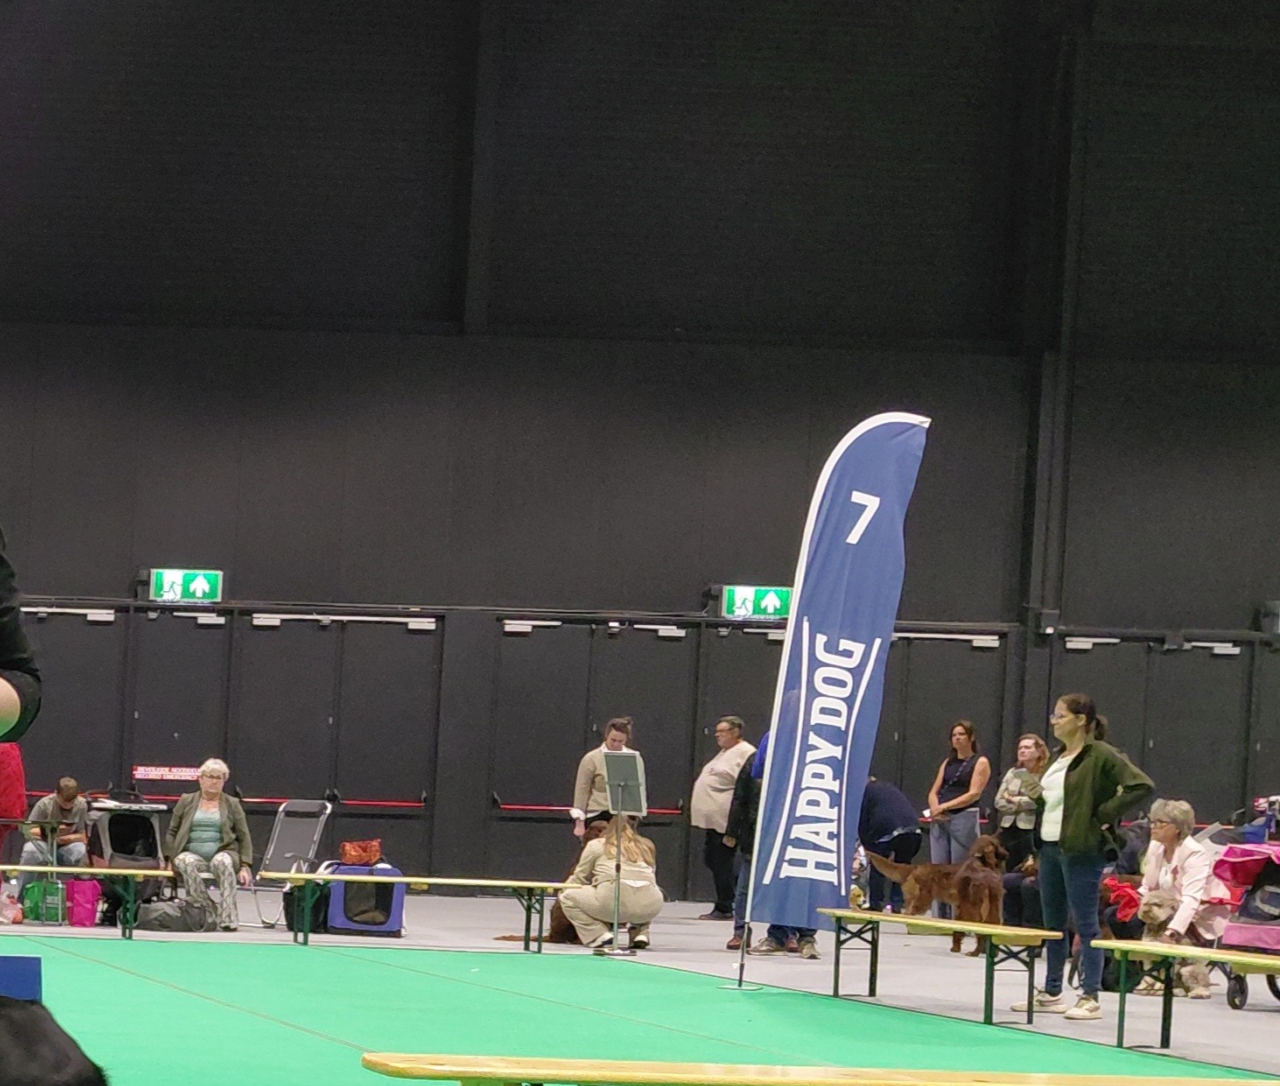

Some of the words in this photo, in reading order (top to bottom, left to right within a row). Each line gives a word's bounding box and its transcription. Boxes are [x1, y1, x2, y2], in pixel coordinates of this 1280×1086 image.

[846, 491, 880, 544] 7
[810, 633, 866, 731] DOG
[779, 731, 842, 886] HAPPY
